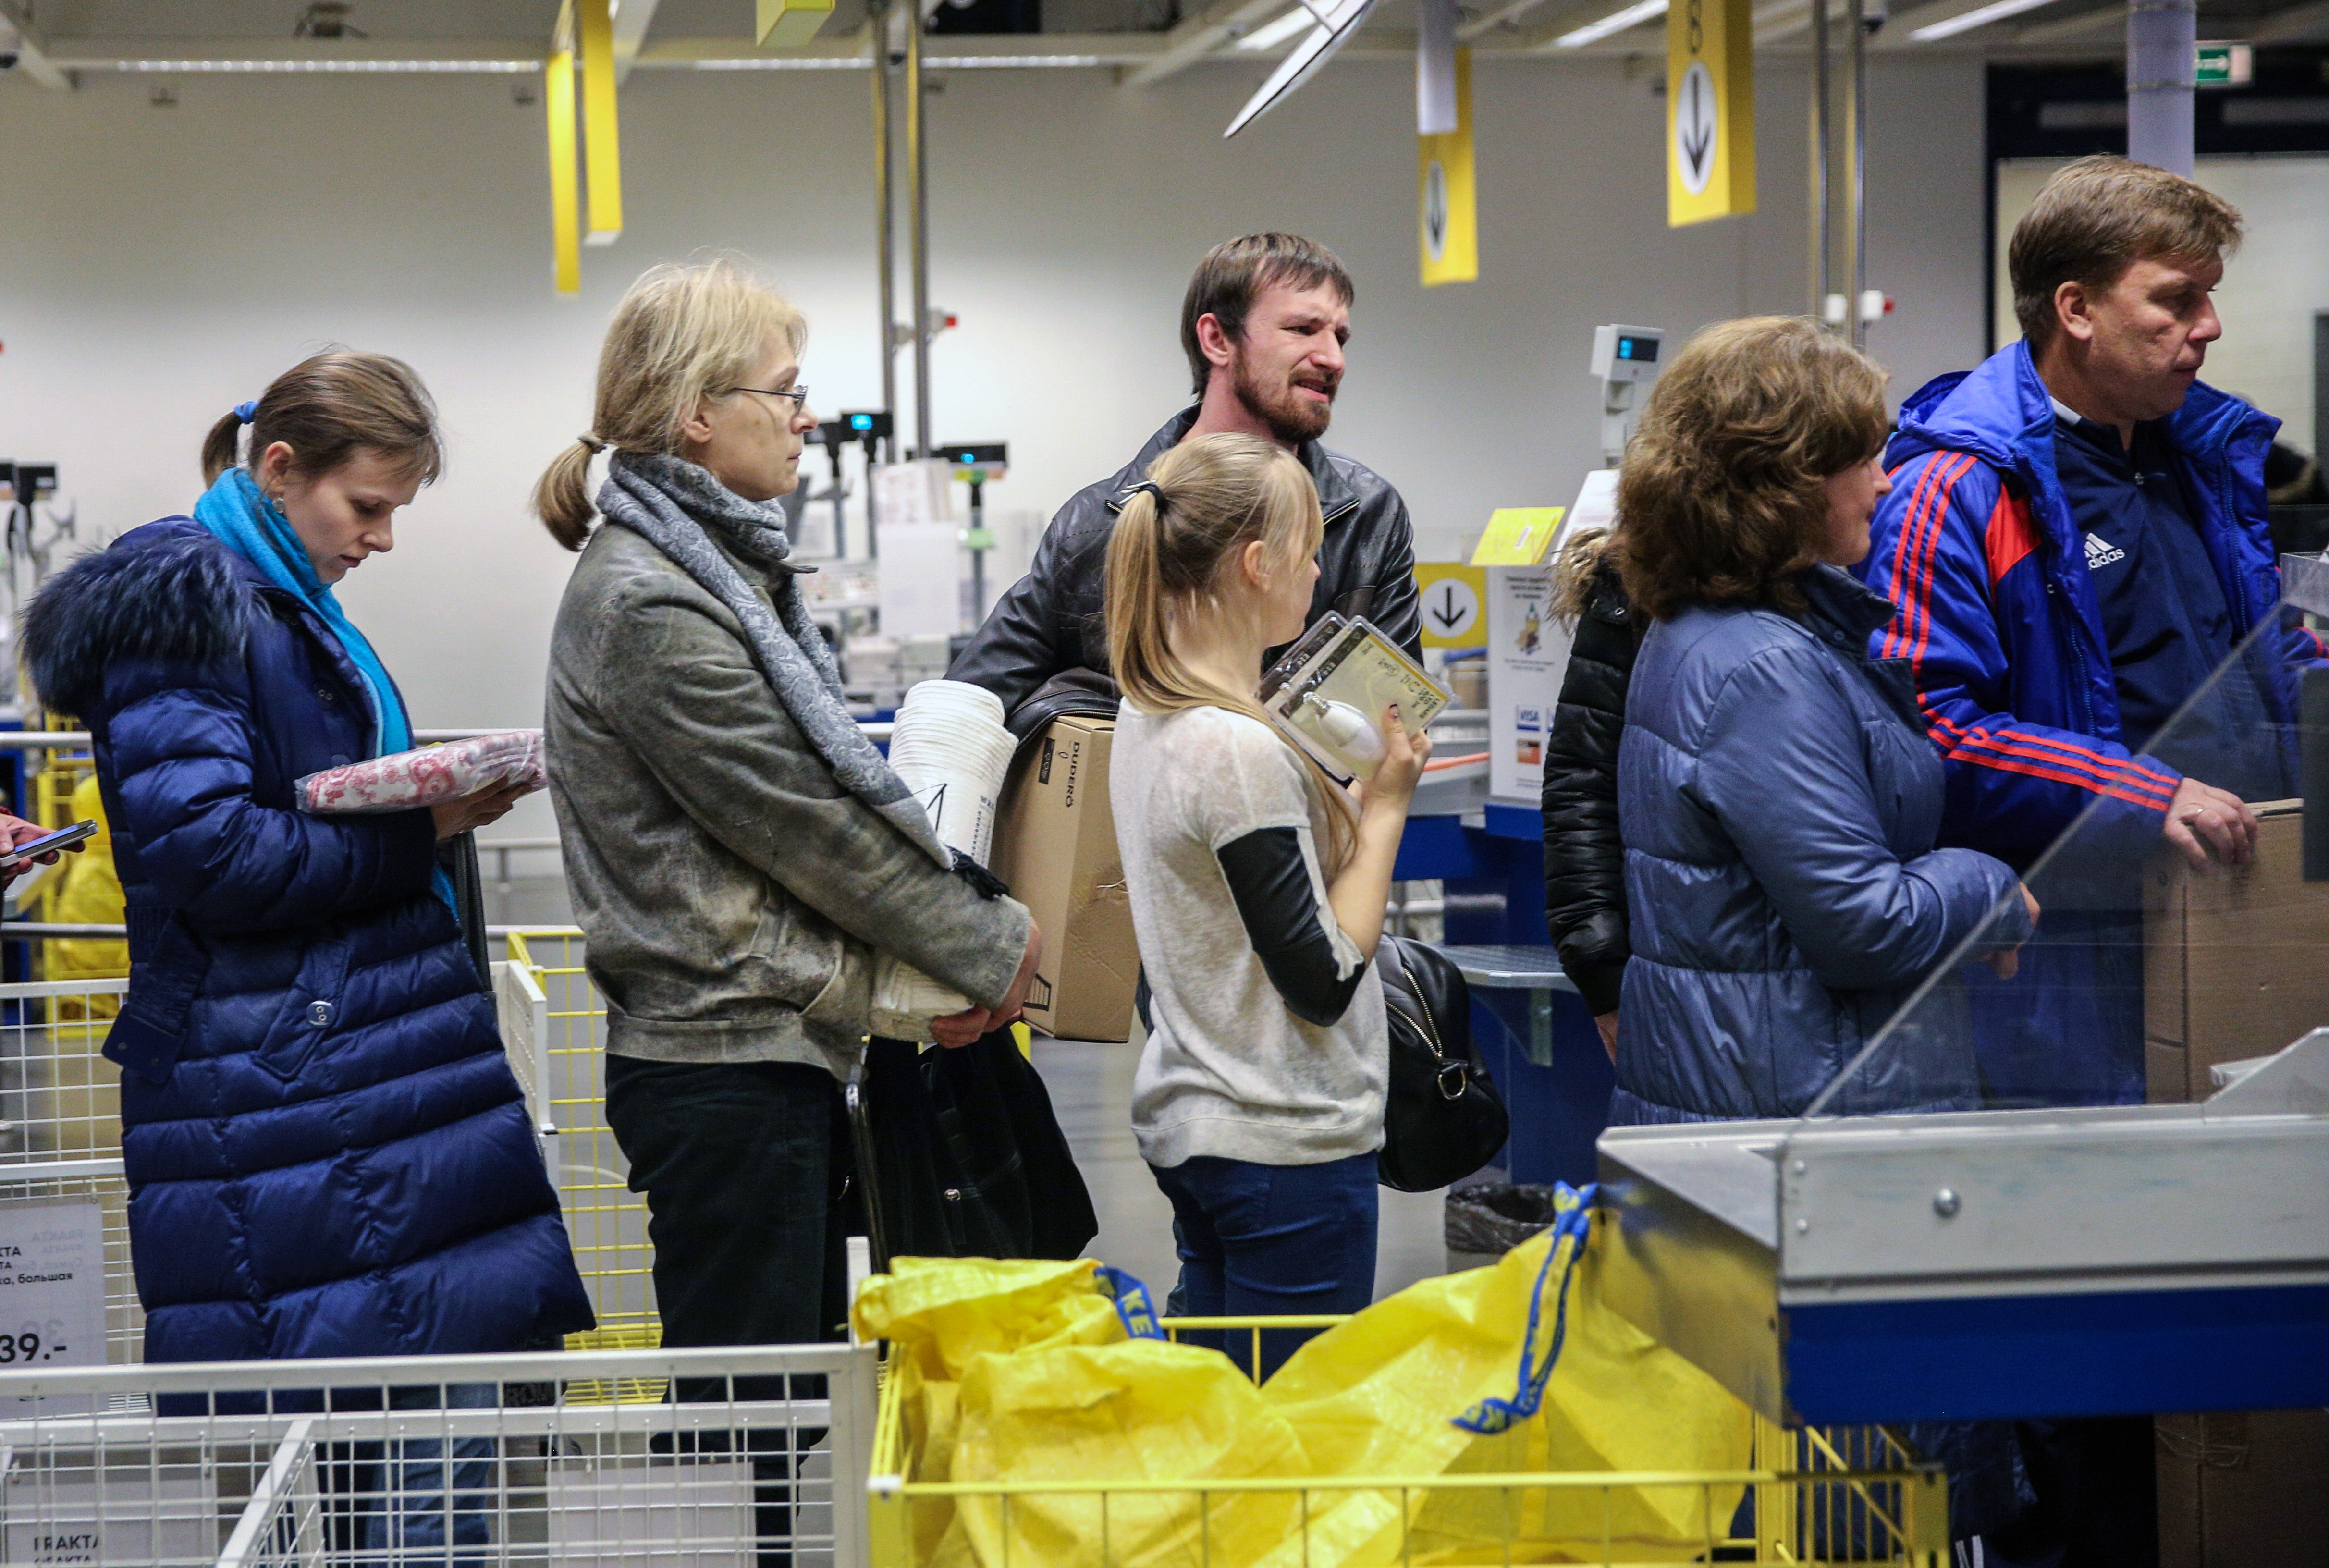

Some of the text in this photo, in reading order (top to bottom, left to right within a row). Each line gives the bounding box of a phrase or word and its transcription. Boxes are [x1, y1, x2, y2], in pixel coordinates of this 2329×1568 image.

[2088, 548, 2125, 571] didas
[1065, 741, 1080, 808] DUDERÖ
[18, 1274, 73, 1284] большая
[1120, 1288, 1154, 1336] KE
